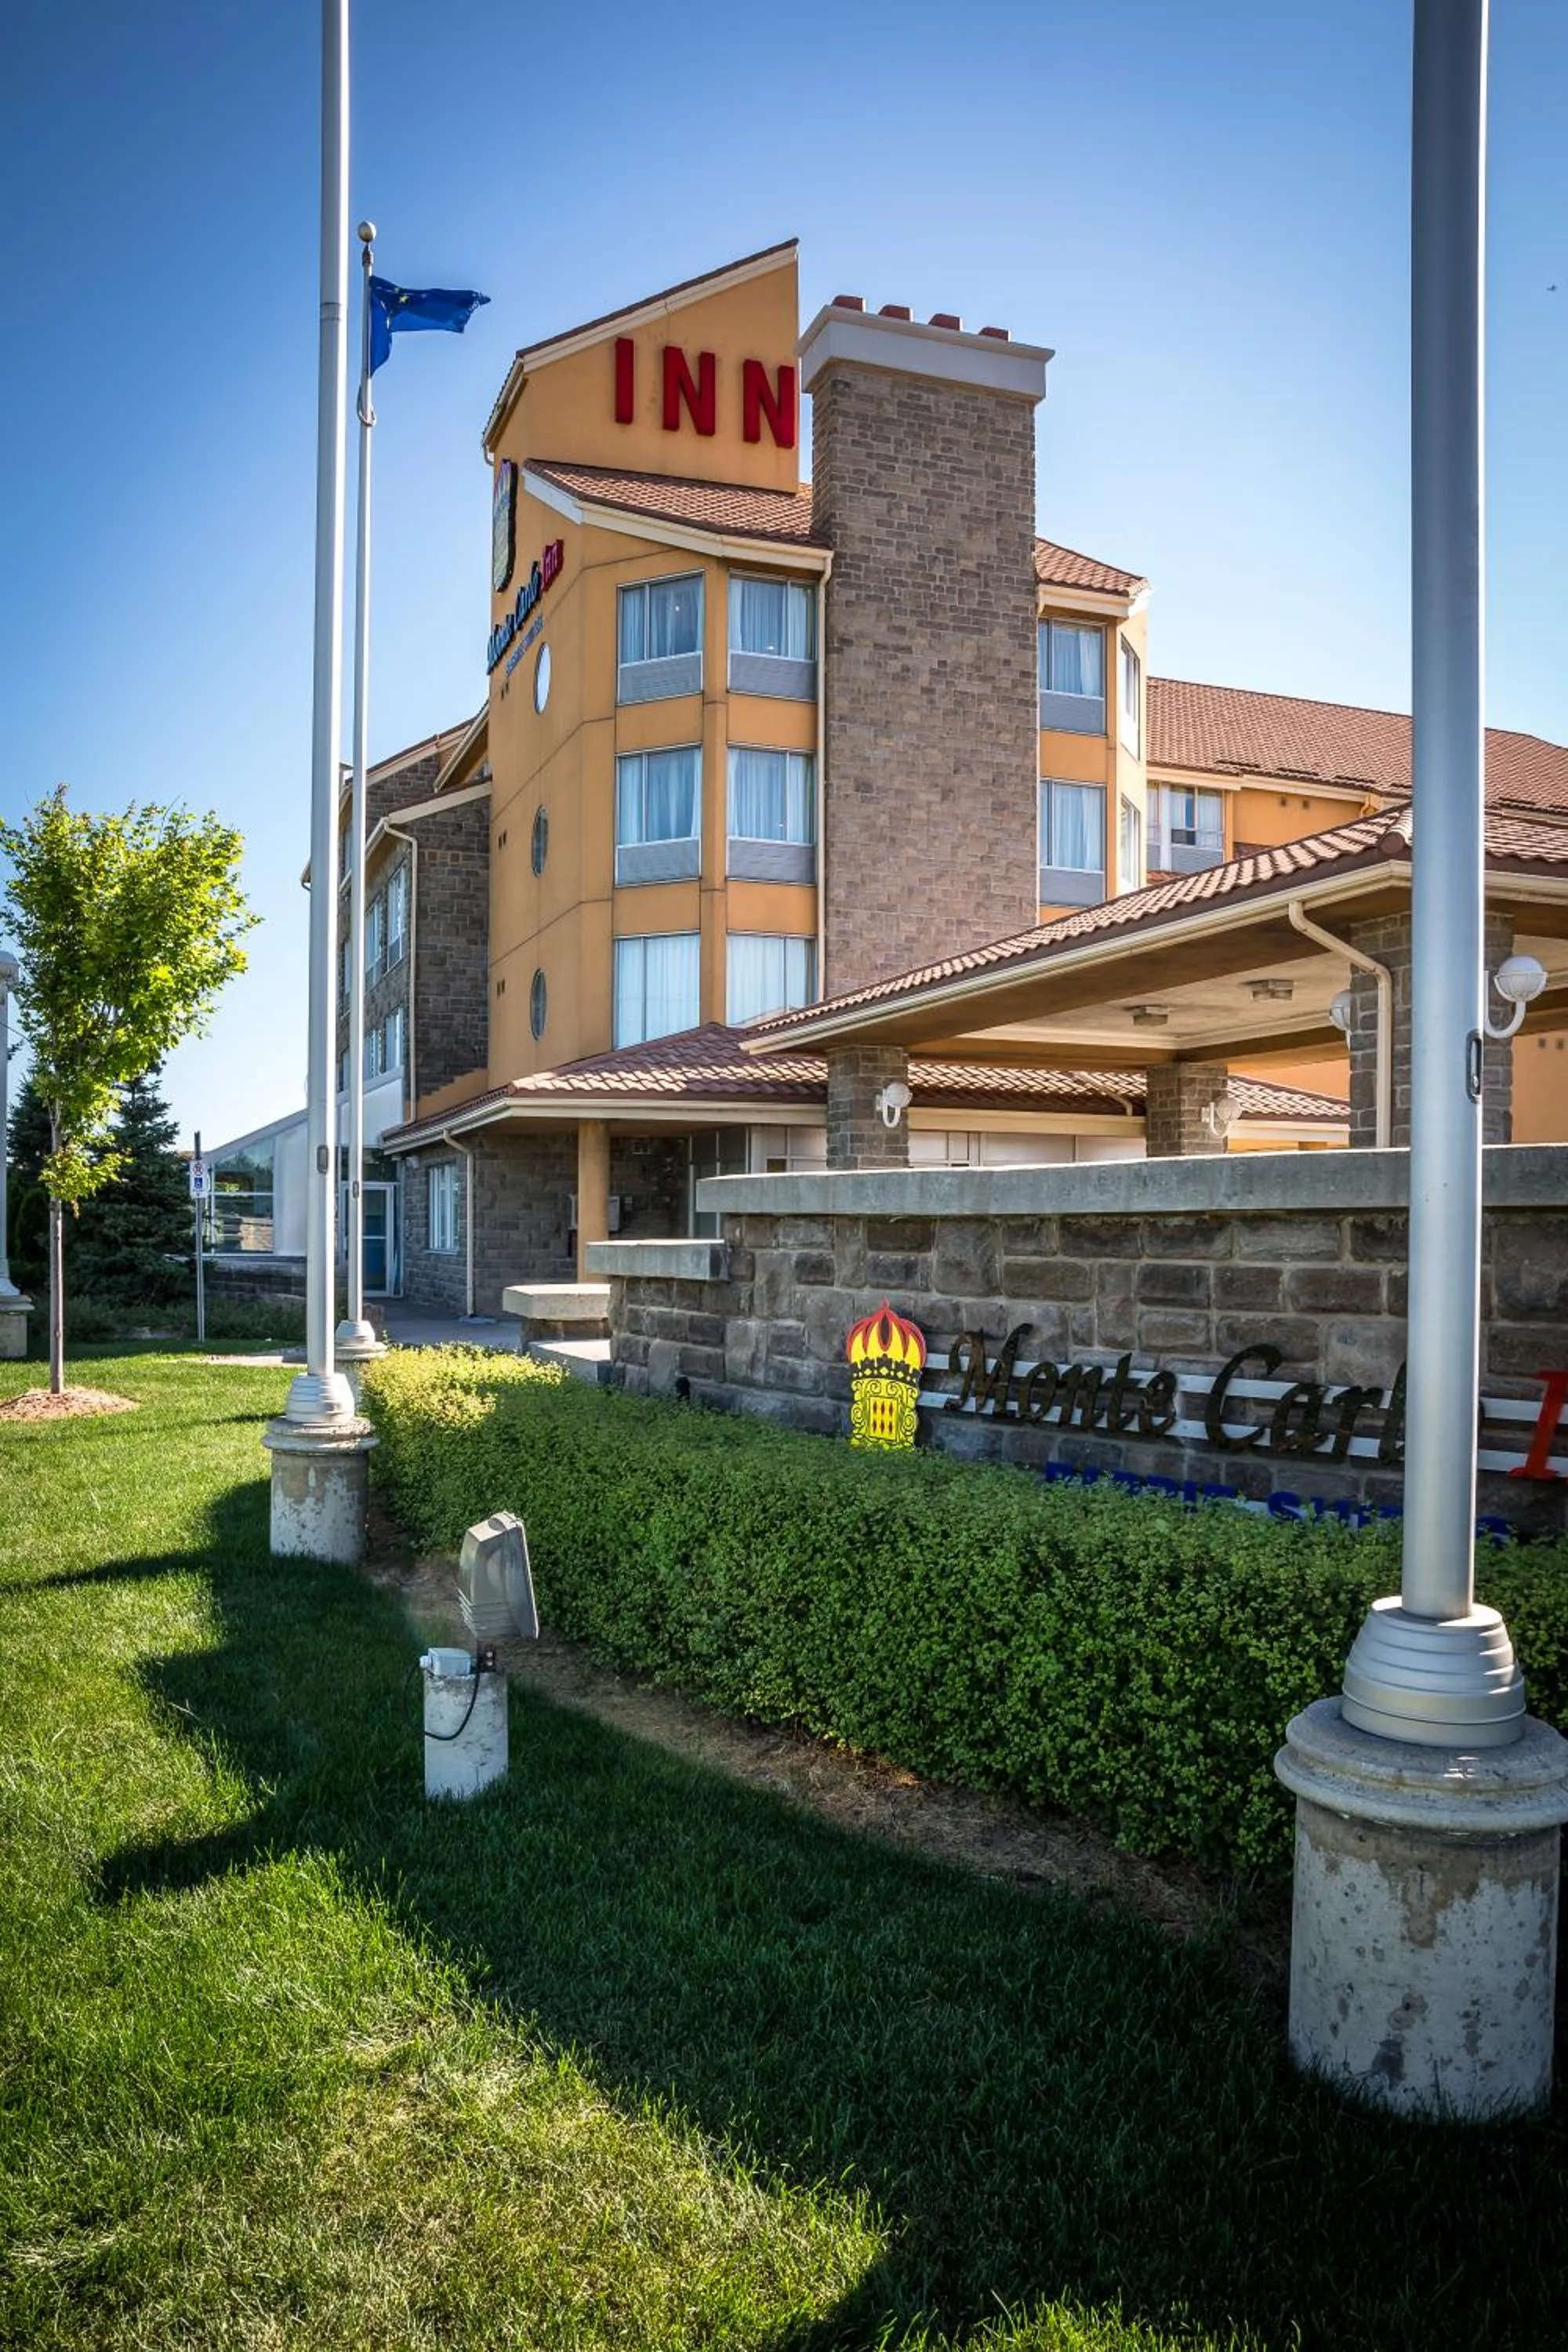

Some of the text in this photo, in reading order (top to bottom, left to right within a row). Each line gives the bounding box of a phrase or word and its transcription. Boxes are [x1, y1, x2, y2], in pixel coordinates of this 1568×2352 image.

[615, 337, 796, 449] INN
[943, 1323, 1177, 1436] Monte
[1205, 1343, 1485, 1465] Carl
